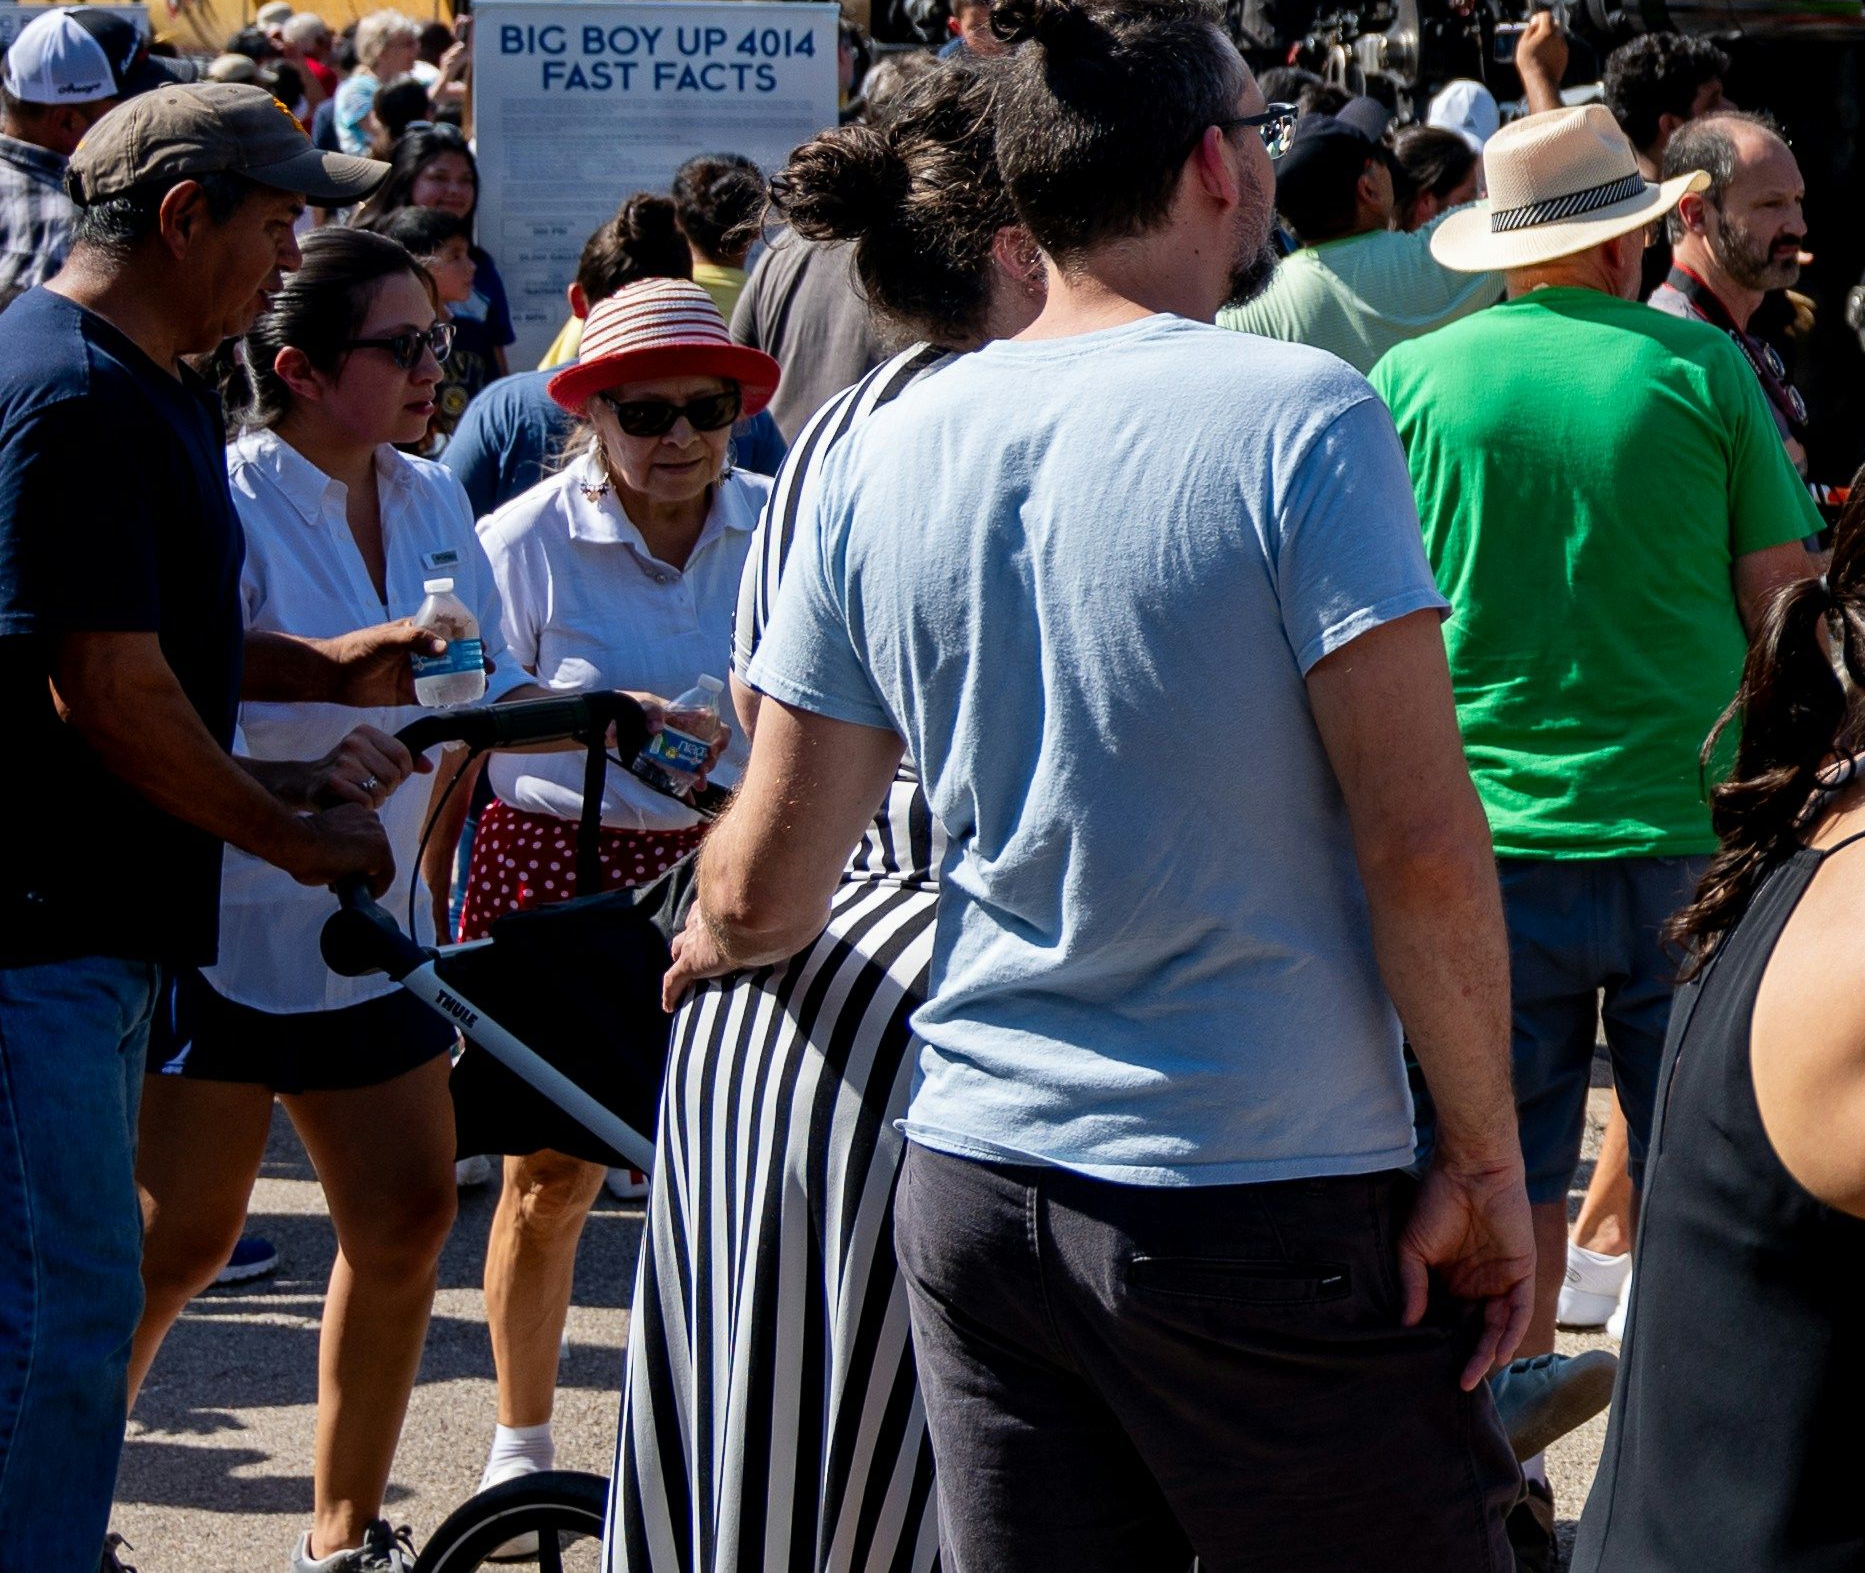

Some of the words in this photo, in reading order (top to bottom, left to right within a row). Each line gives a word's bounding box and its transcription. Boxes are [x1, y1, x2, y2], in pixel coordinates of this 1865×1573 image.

[500, 24, 567, 56] BIG
[582, 24, 662, 56] BOY
[677, 26, 727, 57] UP
[736, 27, 816, 58] 4014
[542, 61, 638, 91] FAST
[654, 61, 777, 93] FACTS
[434, 988, 479, 1029] THULE
